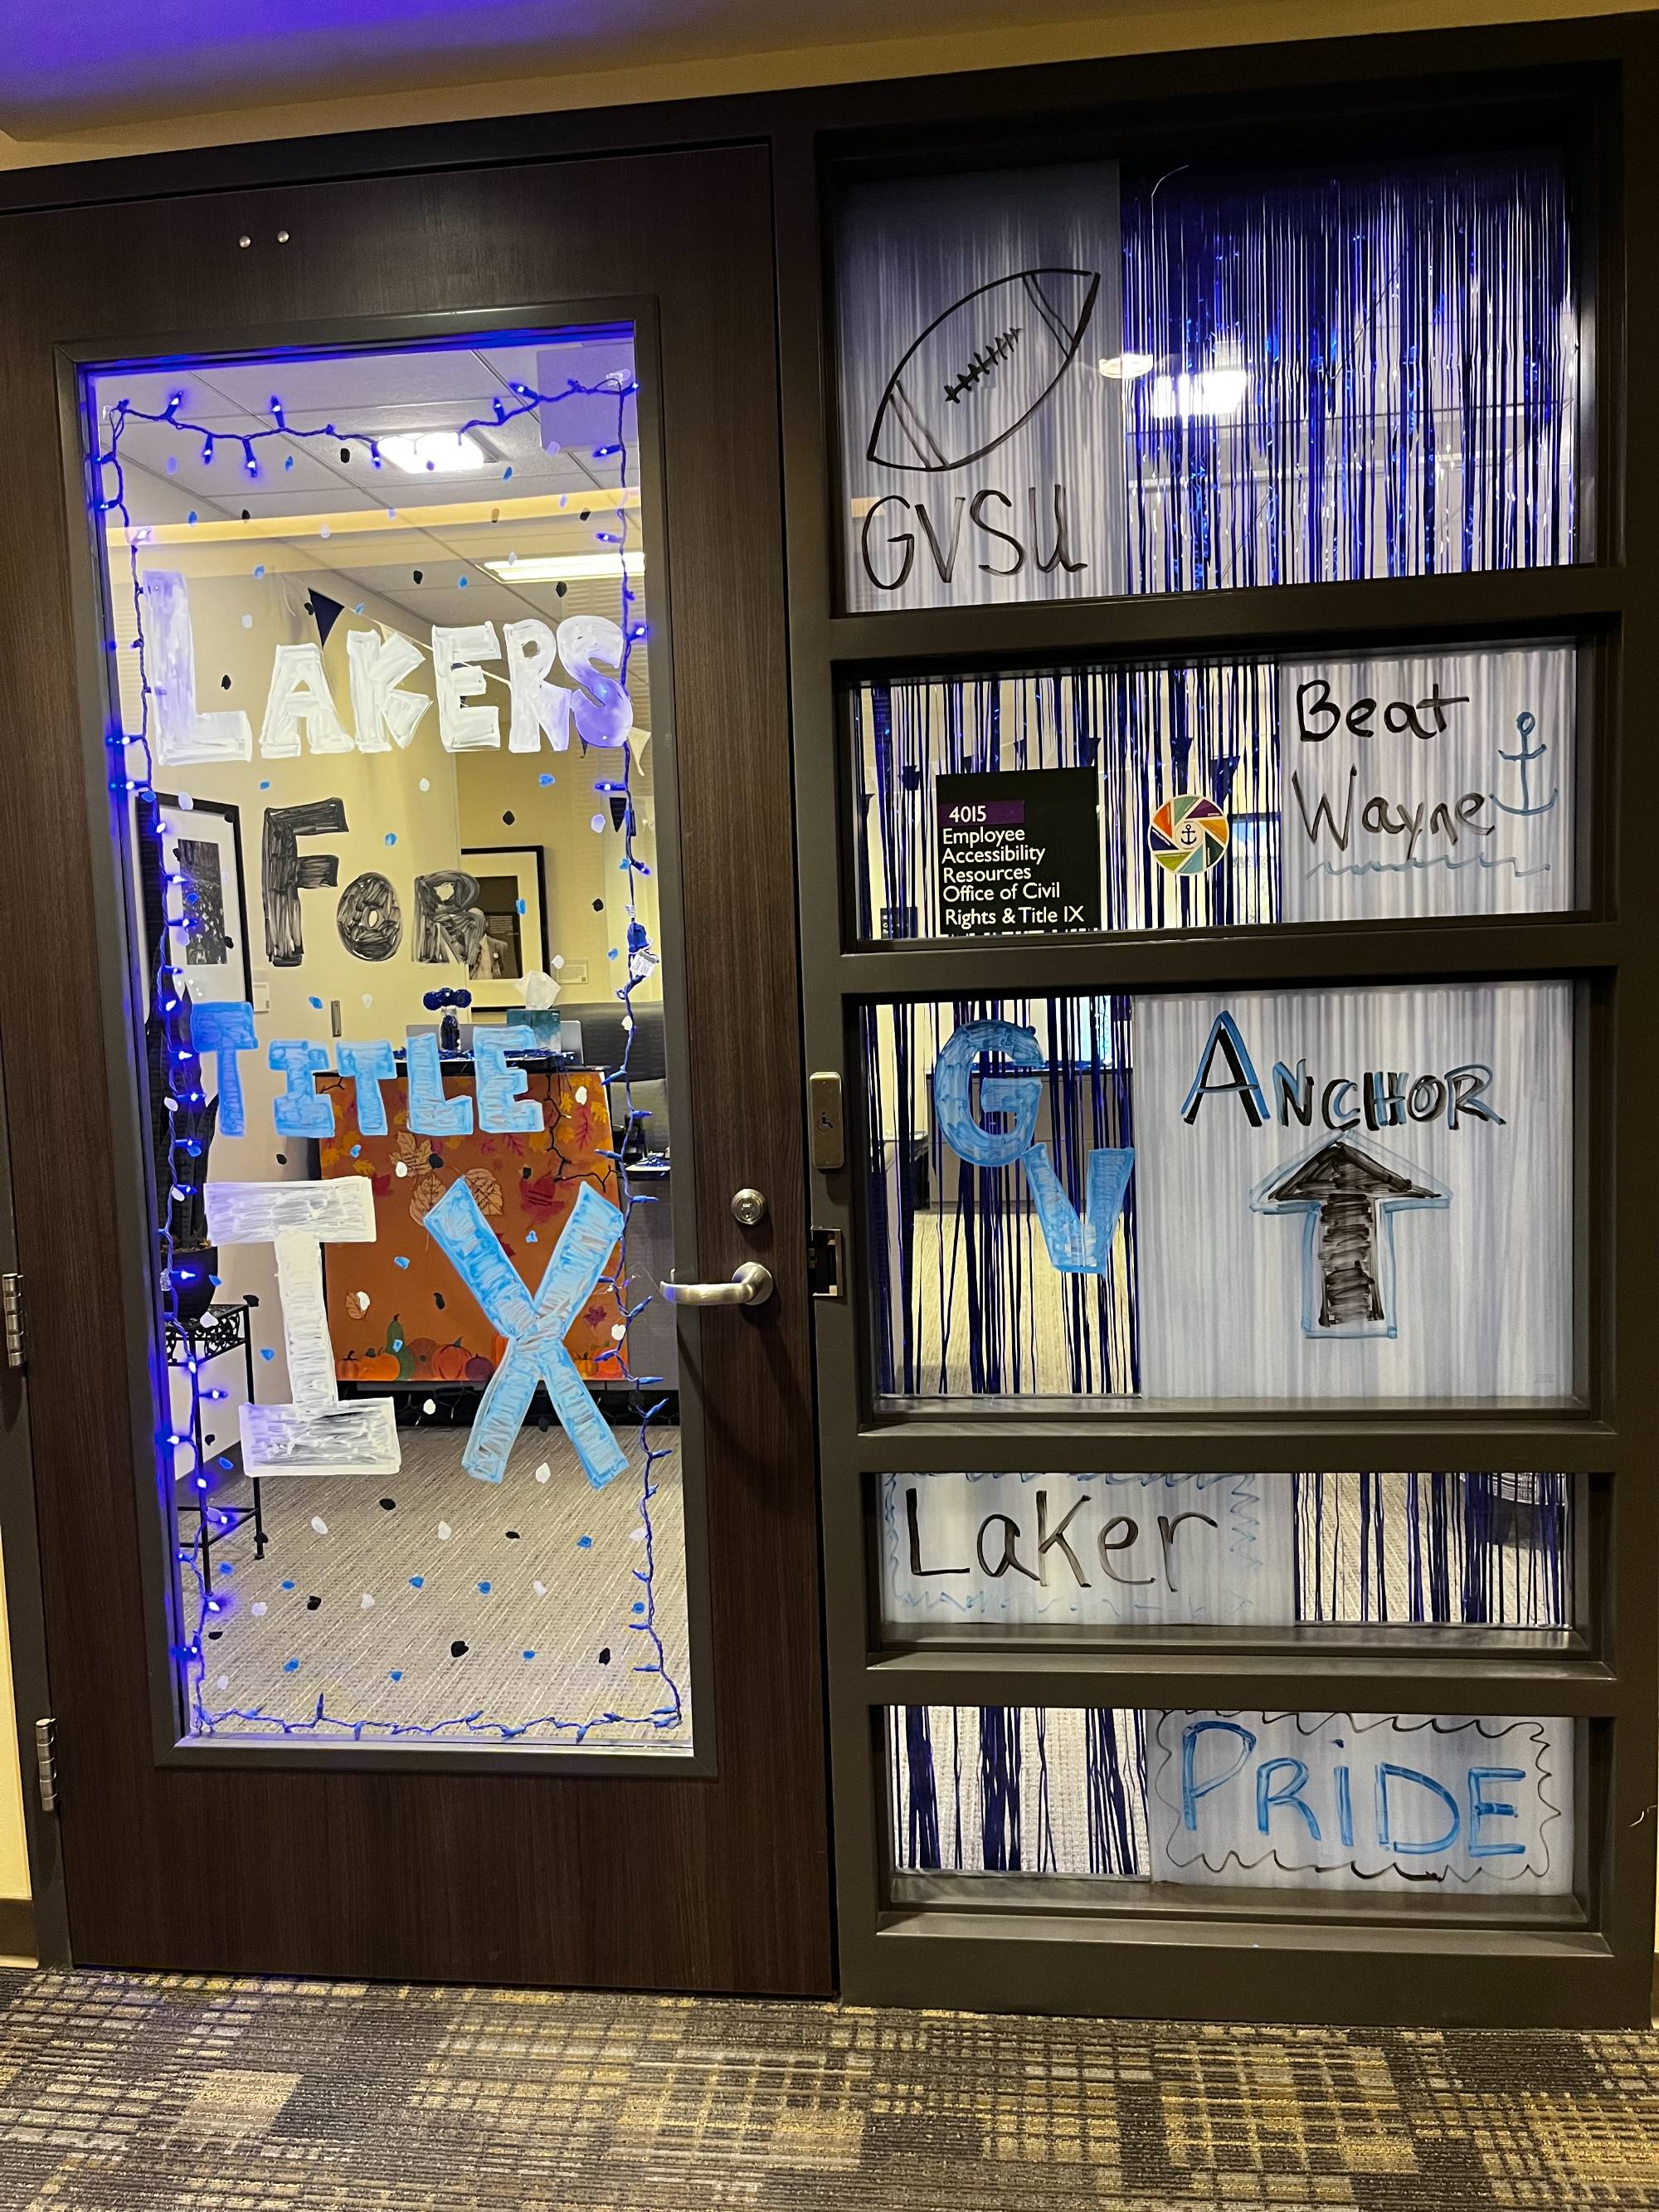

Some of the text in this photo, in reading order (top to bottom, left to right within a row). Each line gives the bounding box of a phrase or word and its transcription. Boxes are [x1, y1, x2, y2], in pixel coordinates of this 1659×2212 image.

[861, 484, 1087, 590] GVSU
[141, 569, 635, 767] LAKERS
[1296, 679, 1470, 742] Beat
[942, 826, 1025, 849] Employee
[948, 805, 987, 823] 4015
[1291, 763, 1496, 861] Wayne
[941, 844, 1046, 865] Accessibility
[942, 881, 1060, 903] Office of Civil
[943, 867, 1032, 884] Resources
[945, 905, 1085, 930] Rights & Title IX
[190, 1001, 545, 1138] TITLE
[1181, 1011, 1508, 1130] ANCHOR
[203, 1176, 625, 1492] IX
[905, 1488, 1219, 1592] Laker
